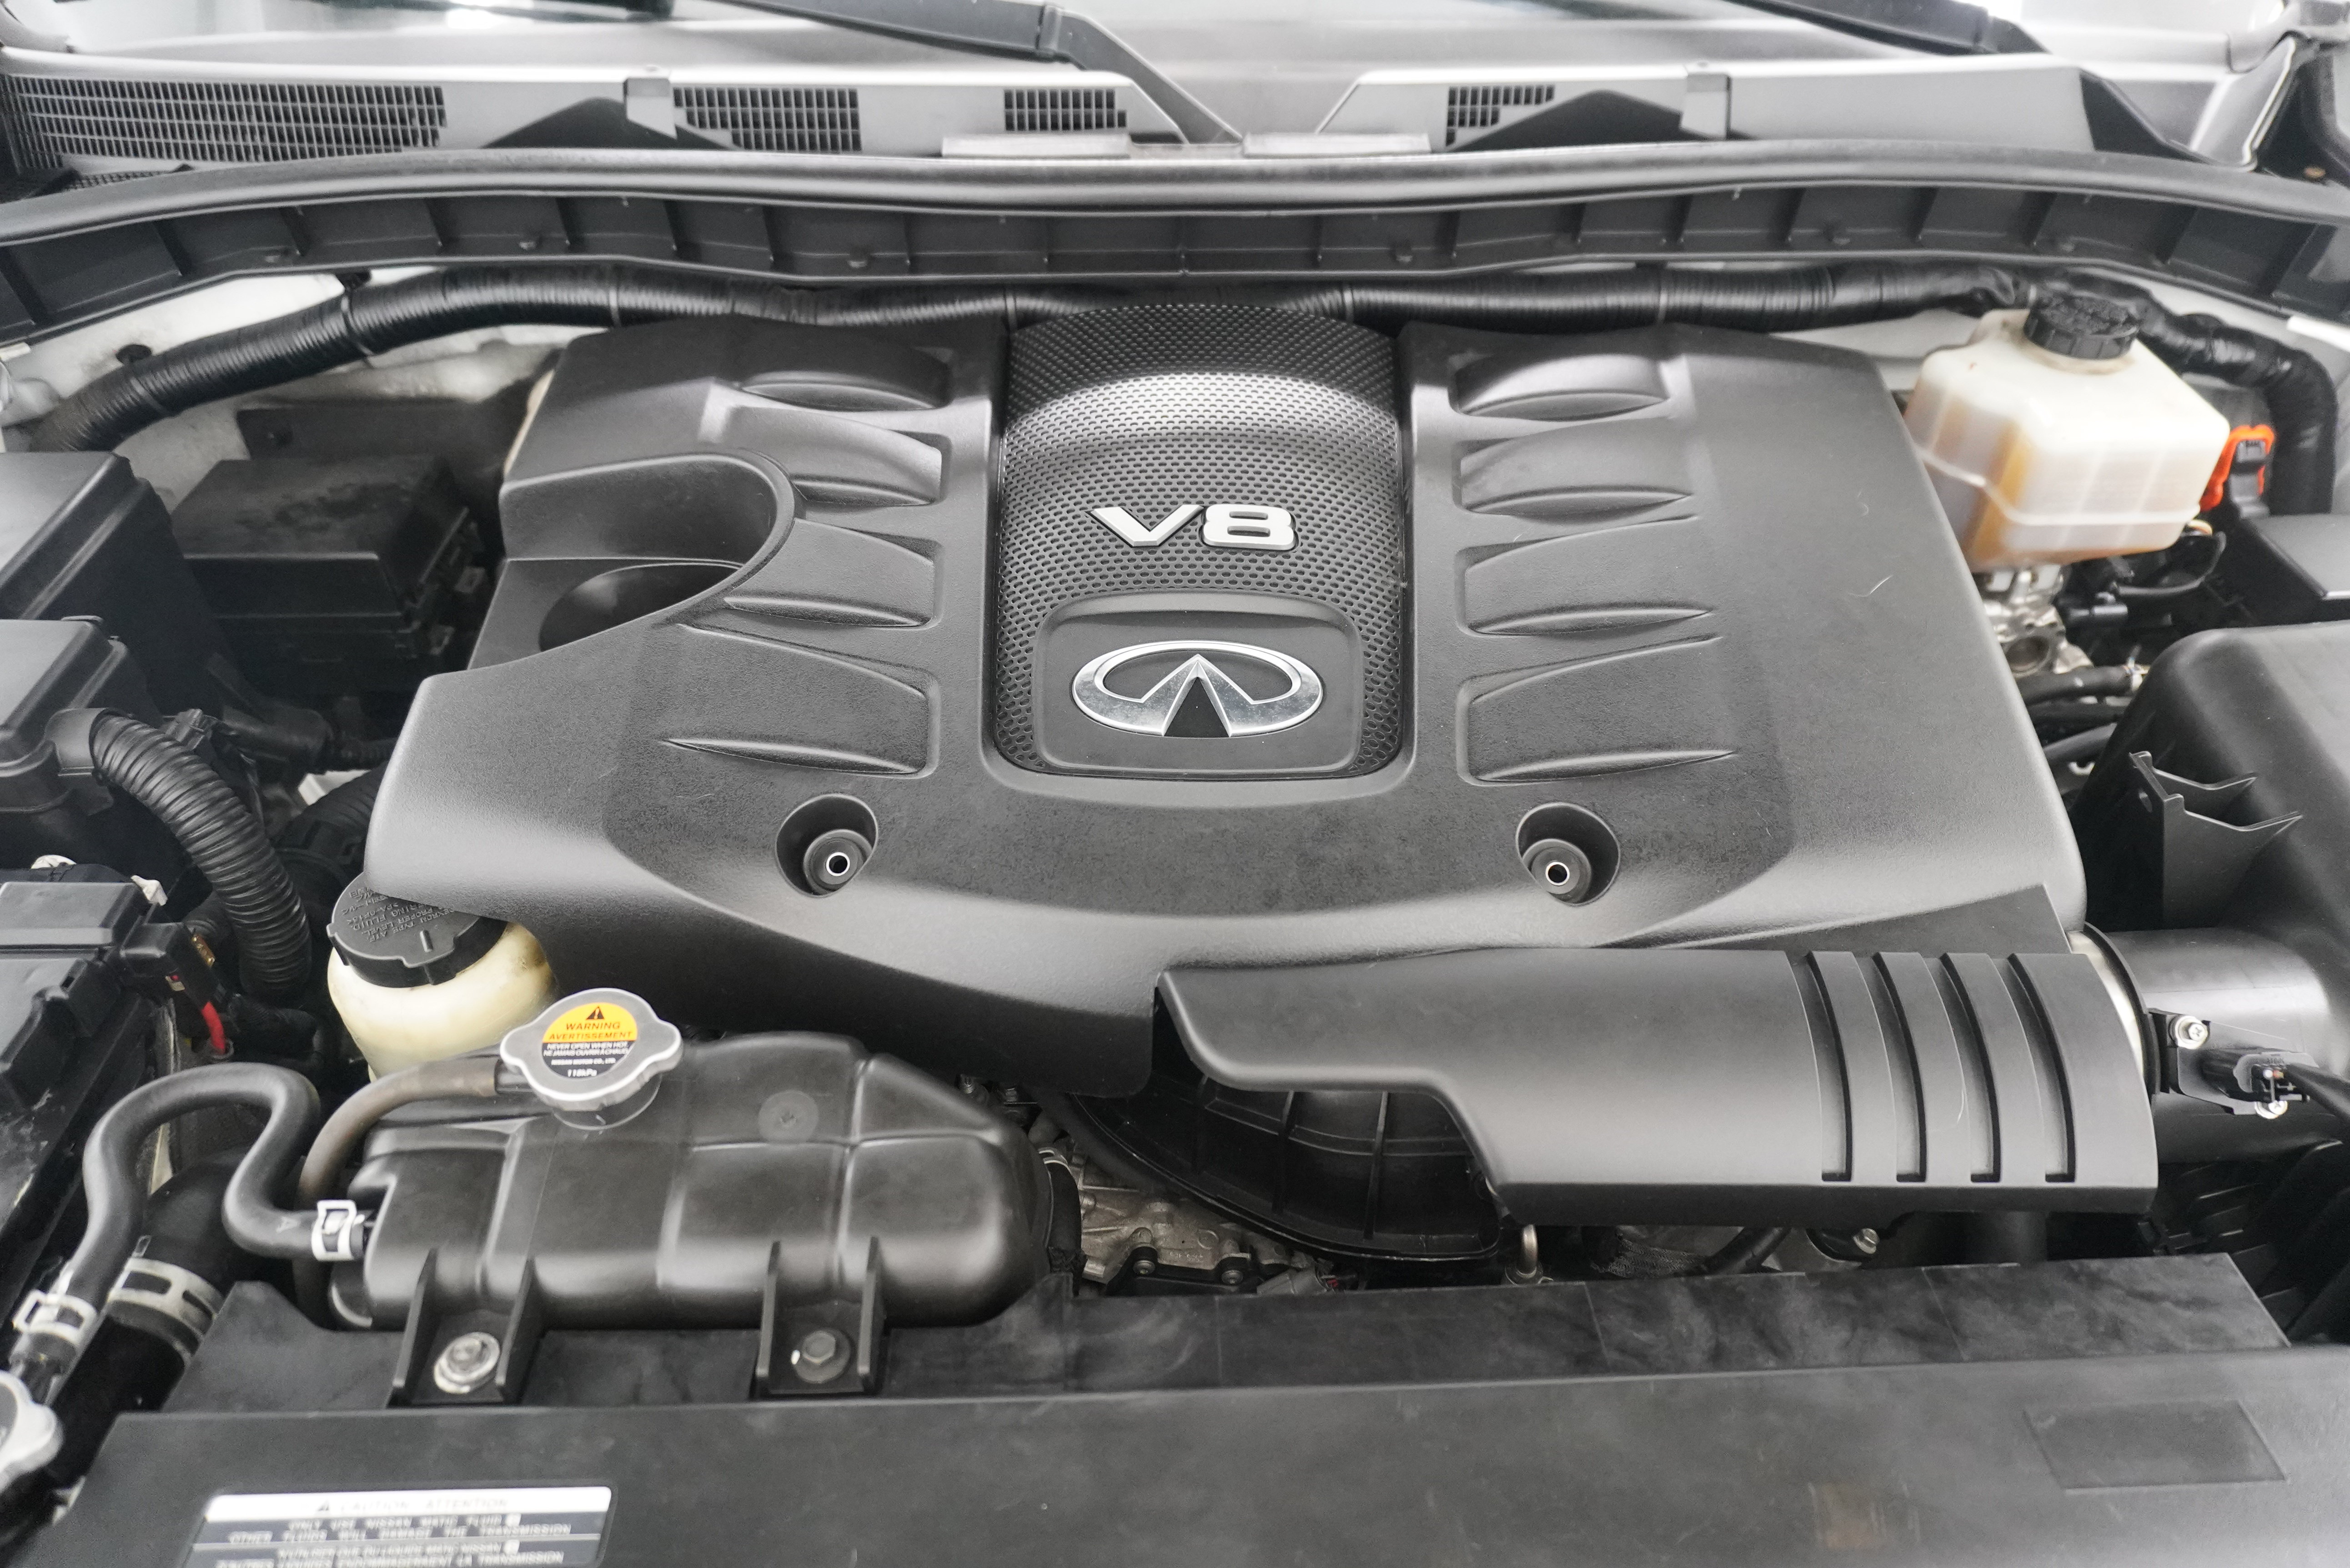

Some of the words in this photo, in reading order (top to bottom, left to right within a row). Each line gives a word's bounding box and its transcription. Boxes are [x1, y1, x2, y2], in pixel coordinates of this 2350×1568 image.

[1090, 504, 1296, 550] V8
[566, 1021, 621, 1030] WARNING
[549, 1031, 633, 1040] AVERTISSEMENT
[426, 1498, 508, 1510] ATTENTION
[479, 1523, 571, 1536] TRANSMISSION
